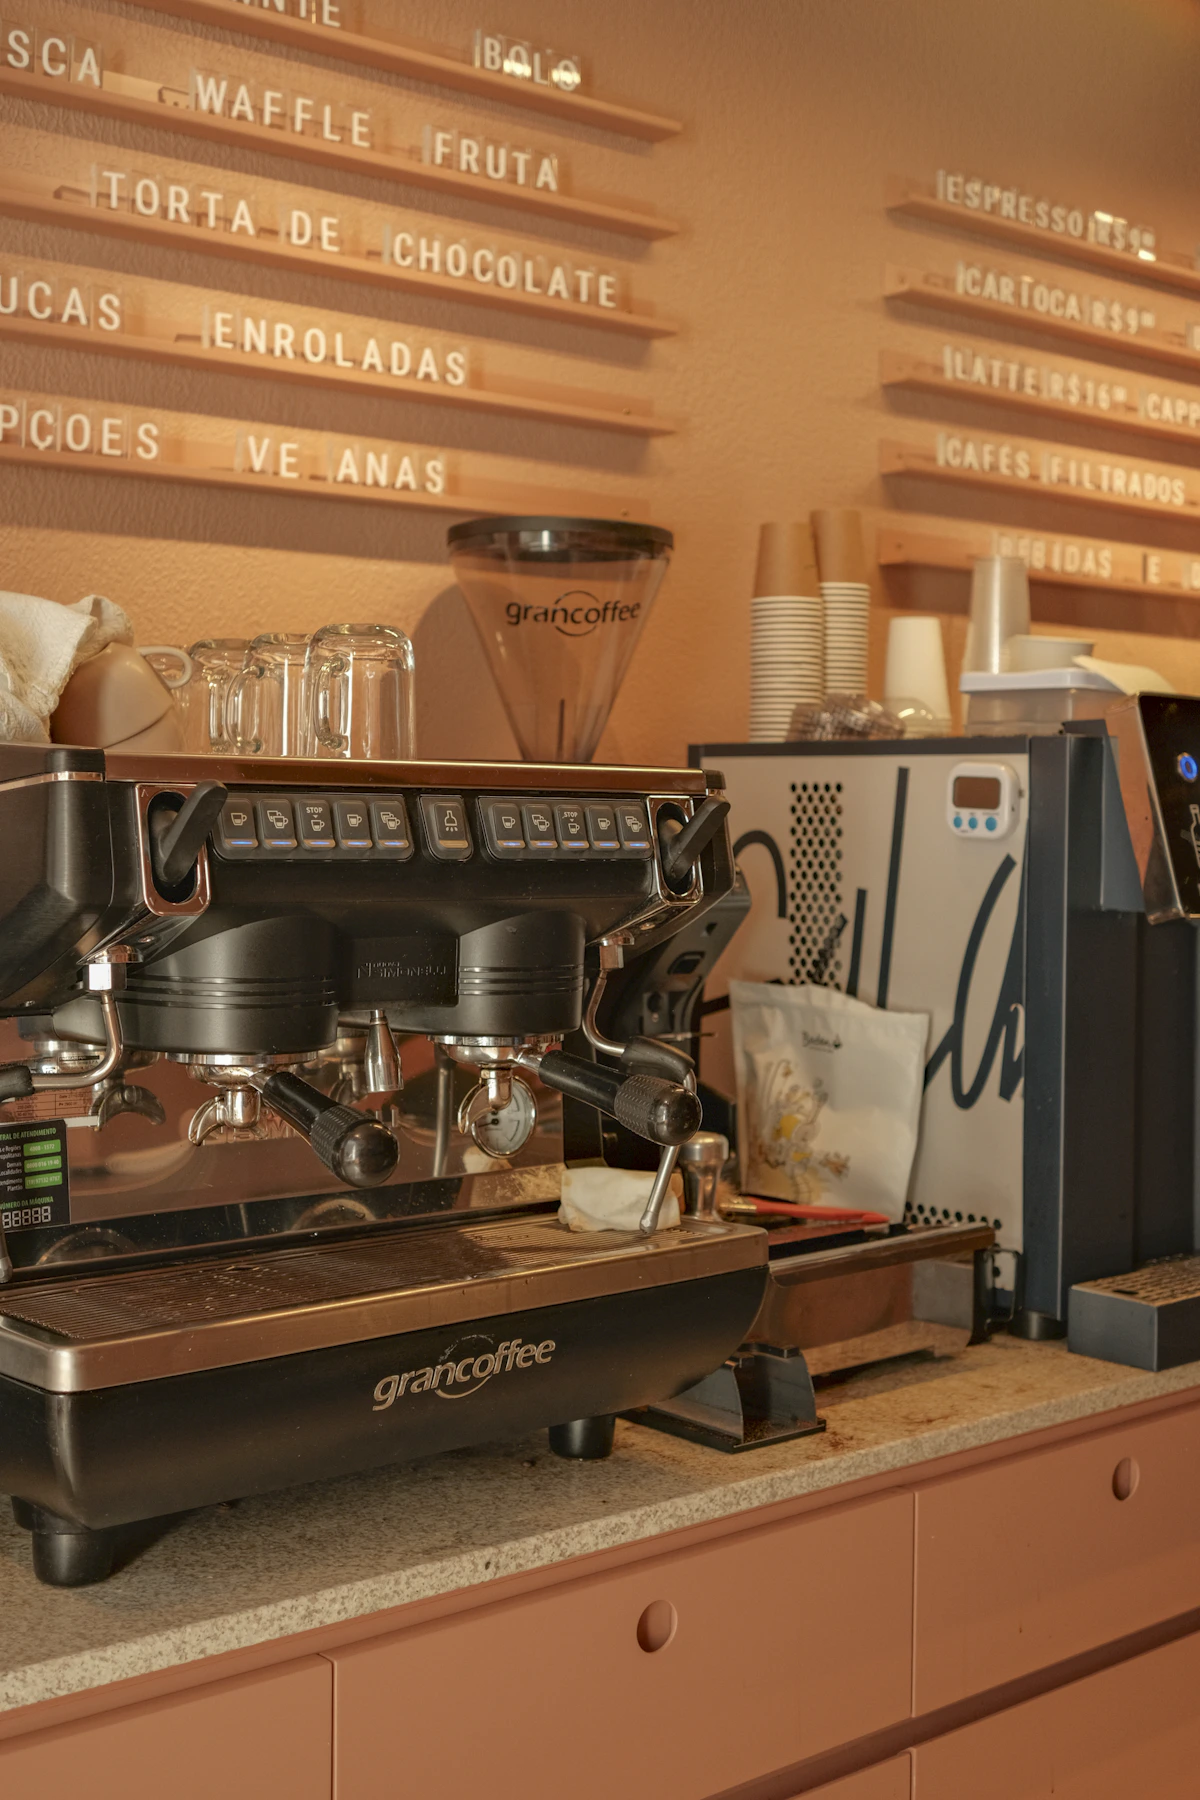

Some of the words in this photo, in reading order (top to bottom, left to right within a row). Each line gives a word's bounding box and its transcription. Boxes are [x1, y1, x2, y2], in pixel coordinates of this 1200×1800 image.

[7, 29, 101, 87] SCA
[484, 37, 578, 91] BOLO
[196, 74, 371, 148] WAFFLE
[434, 132, 558, 192] FRUTA
[945, 174, 1083, 238] ESPRESSO
[102, 171, 255, 236] TORTA
[290, 210, 340, 252] DE
[393, 232, 617, 308] CHOCOLATE
[0, 275, 121, 331] UCAS
[214, 312, 466, 386] ENROLADAS
[953, 351, 1038, 396] LATTE
[336, 448, 444, 494] ANAS
[1050, 455, 1185, 507] FILTRADOS
[505, 600, 641, 625] grancoffee
[306, 806, 323, 814] STOP
[563, 811, 578, 819] STOP
[20, 1127, 57, 1138] ATENDIMENTO
[372, 1338, 556, 1411] grancoffee
